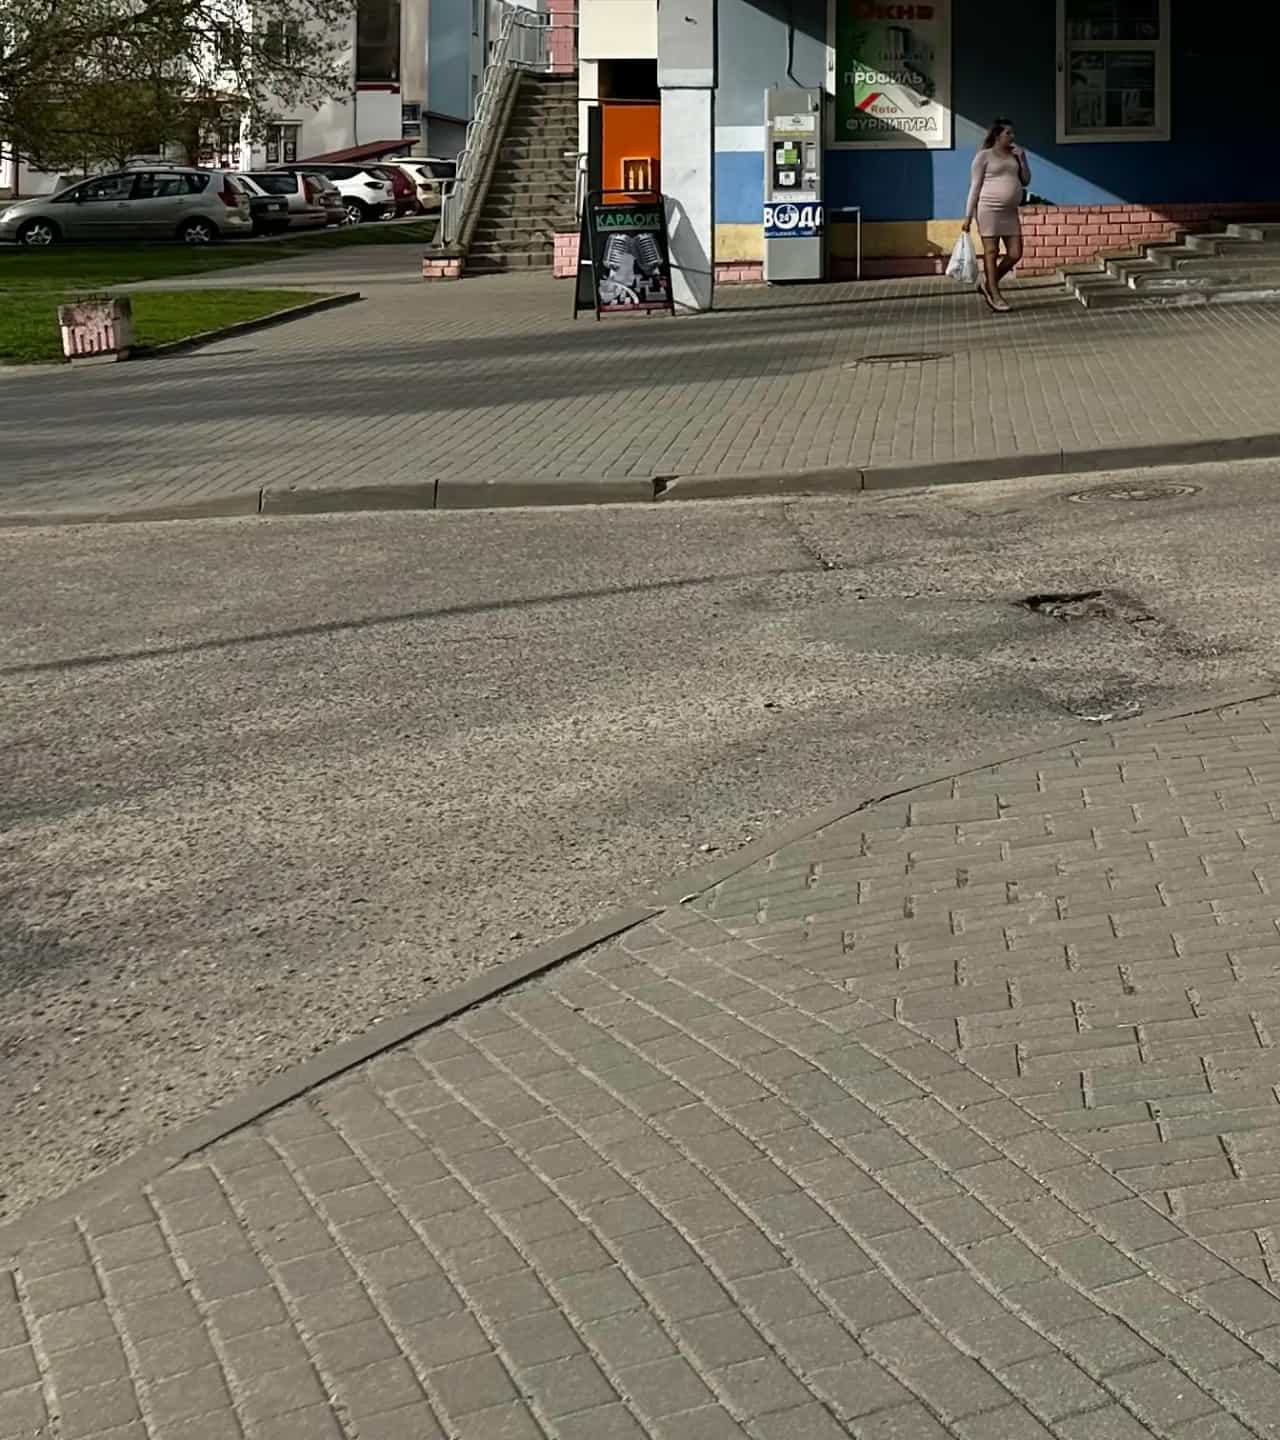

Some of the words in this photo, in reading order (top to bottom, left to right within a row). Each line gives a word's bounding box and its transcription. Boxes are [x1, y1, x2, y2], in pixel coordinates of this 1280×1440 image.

[844, 71, 924, 86] ПРОФИЛЬ
[846, 116, 938, 133] ФУРНИТУРА
[595, 213, 661, 227] КАРАОКЕ
